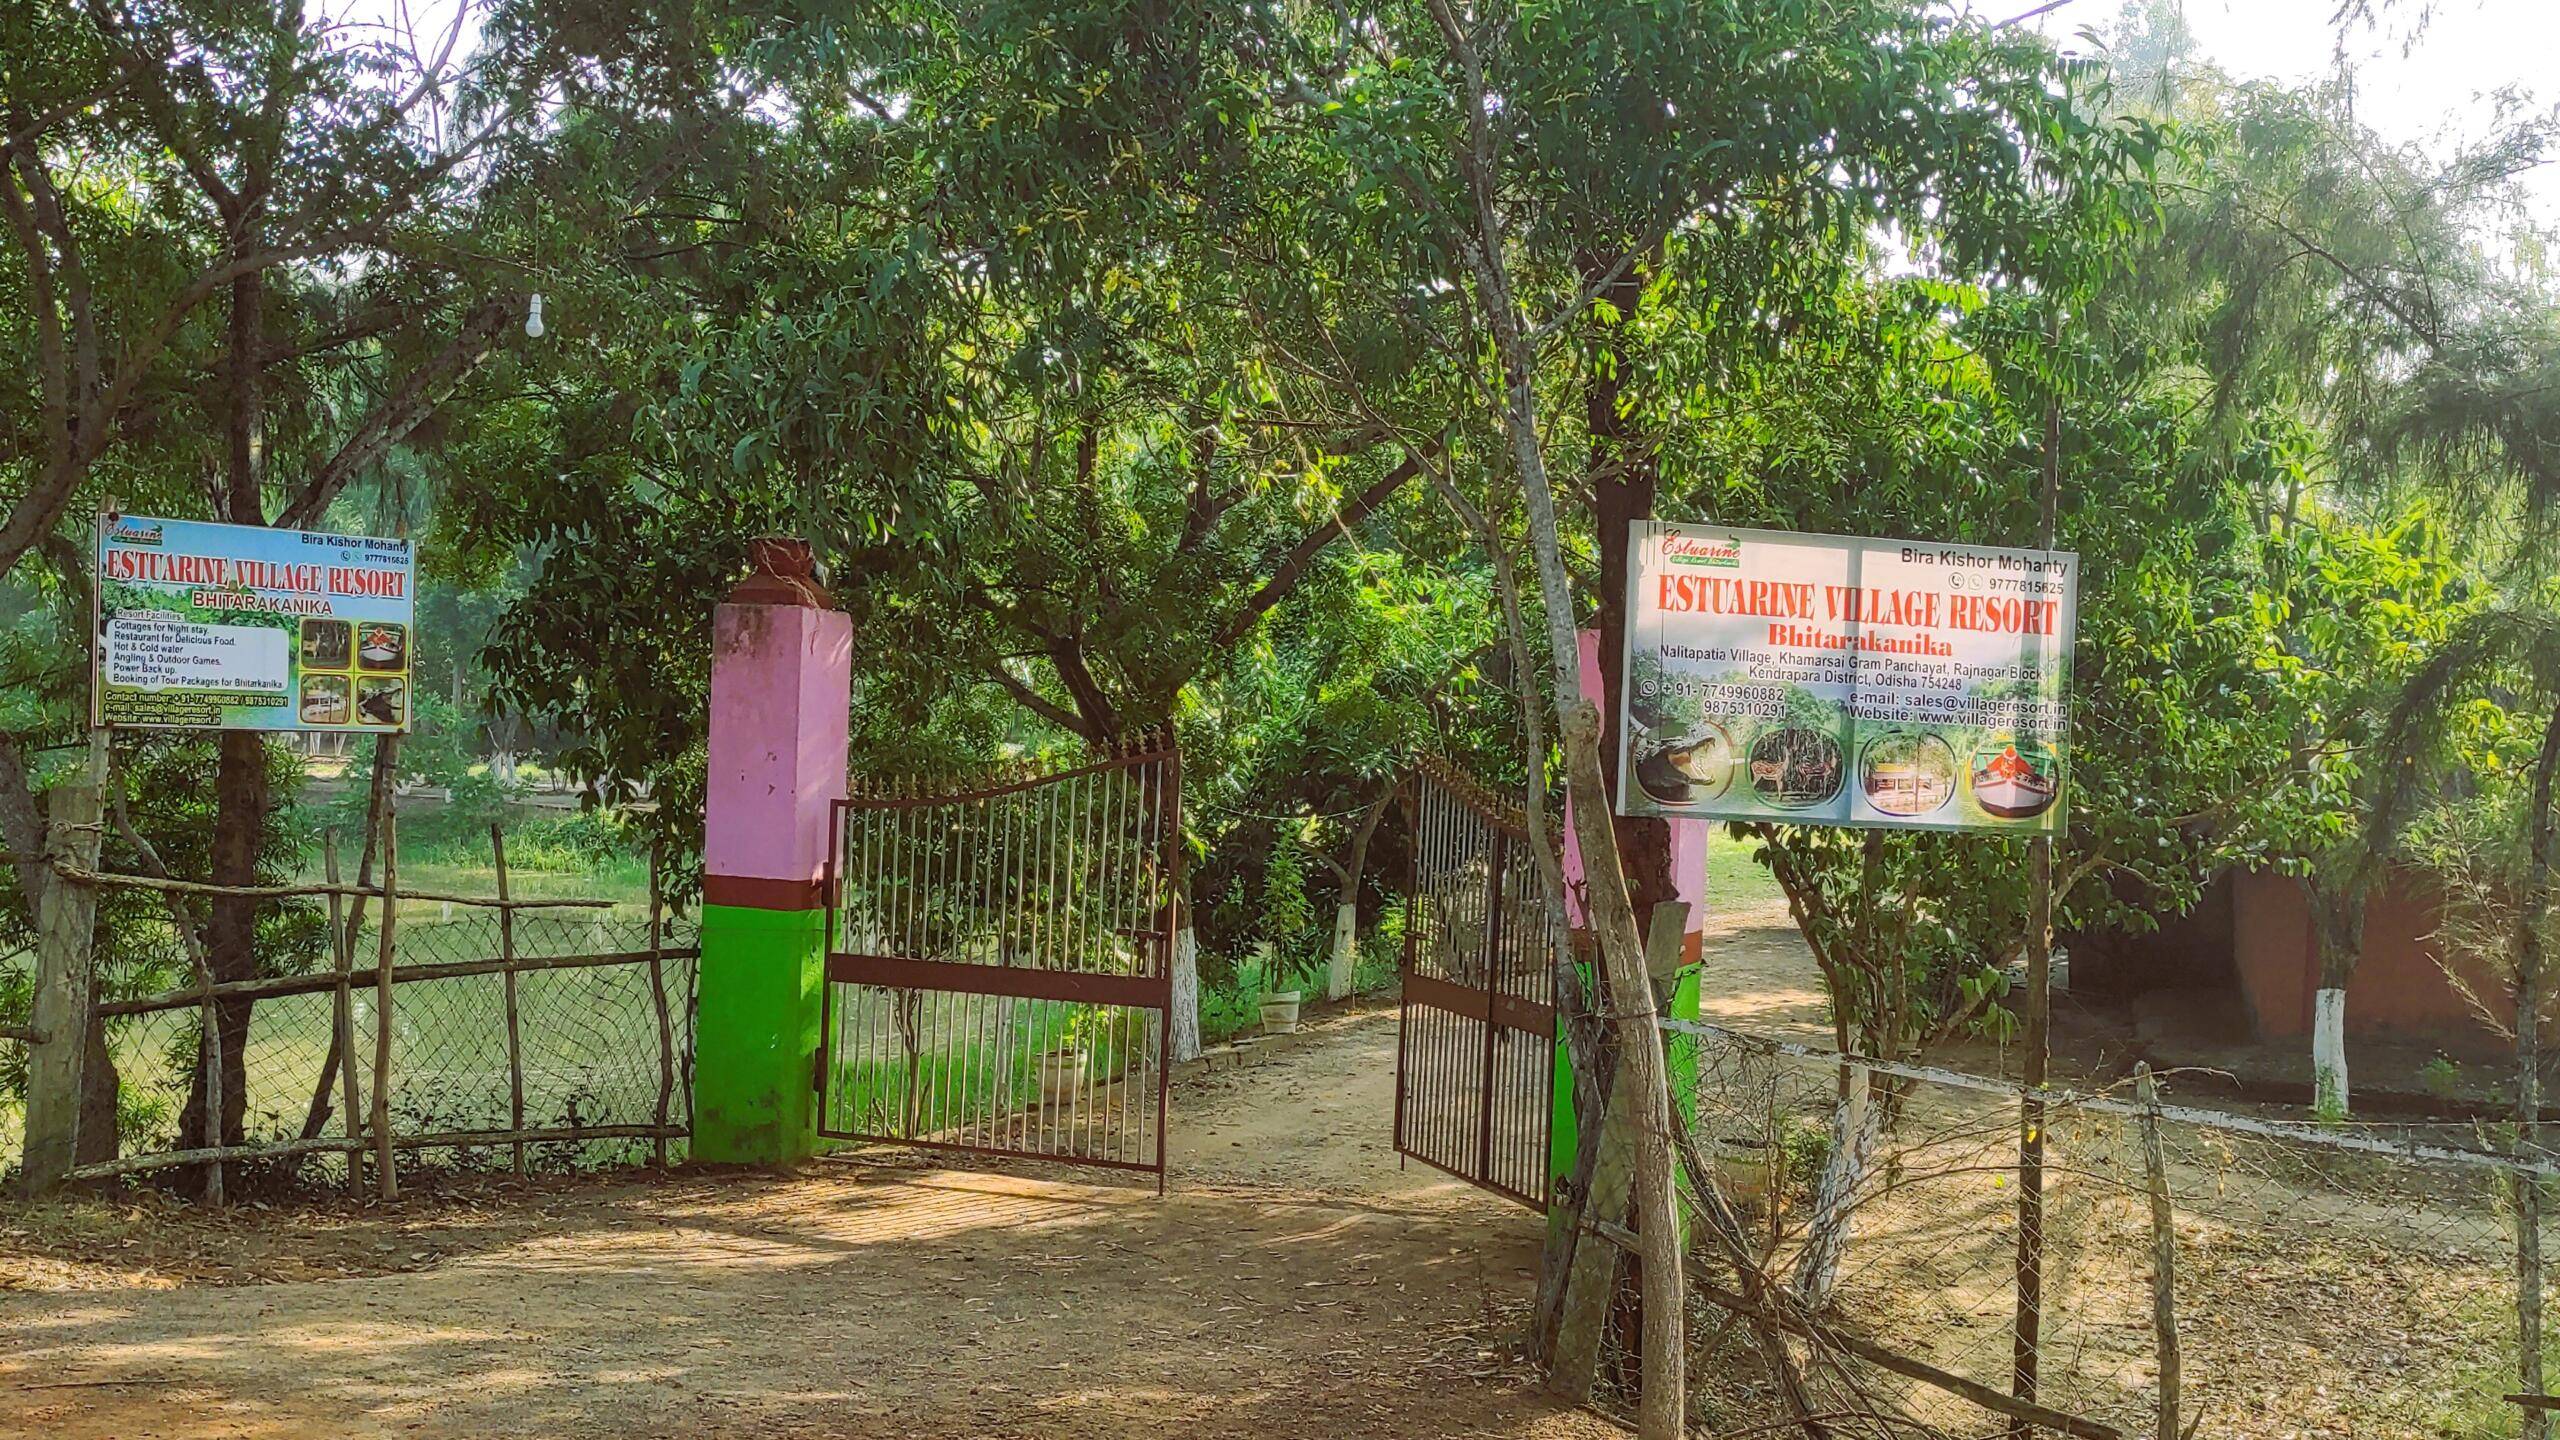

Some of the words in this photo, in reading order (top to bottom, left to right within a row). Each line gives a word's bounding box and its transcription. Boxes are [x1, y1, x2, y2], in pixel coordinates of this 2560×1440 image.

[302, 533, 323, 545] Bira
[326, 536, 361, 549] Kishor
[365, 539, 409, 554] Mohanty
[1661, 529, 1741, 558] Estuarine
[1901, 548, 1934, 565] Bira
[1939, 550, 1993, 570] Kishor
[1998, 555, 2068, 578] Mohanty
[107, 549, 229, 587] ESTUARINE
[235, 559, 322, 594] VILLAGE
[328, 566, 407, 598] RESORT
[1989, 578, 2064, 595] 9777815625
[193, 591, 333, 615] BHITARAKANIKA
[1658, 573, 1816, 621] ESTUARINE
[1825, 585, 1940, 630] VILLAGE
[1949, 594, 2058, 636] RESORT
[117, 608, 144, 618] Resort
[114, 620, 151, 633] Cottages
[153, 623, 165, 632] for
[167, 623, 189, 634] Night
[114, 631, 160, 641] Restaurant
[161, 633, 173, 643] for
[175, 633, 212, 645] Delicious
[114, 641, 129, 651] Hot
[131, 642, 137, 651] &
[139, 642, 159, 652] Cold
[160, 645, 184, 654] water
[1768, 623, 1953, 657] Bhitarakanika
[113, 662, 140, 672] Power
[142, 663, 162, 673] Back
[114, 652, 146, 664] Angling
[148, 653, 154, 663] &
[157, 654, 190, 665] Outdoor
[1660, 645, 1726, 664] Nalitapatia
[1730, 649, 1775, 666] Village,
[1779, 652, 1845, 668] Khamarsai
[1848, 656, 1881, 671] Gram
[1885, 658, 1950, 677] Panchayat,
[1954, 662, 2007, 680] Rajnagar
[113, 673, 148, 685] Booking
[150, 675, 159, 684] of
[161, 675, 179, 685] Tour
[181, 675, 220, 688] Packages
[221, 677, 232, 687] for
[1749, 665, 1821, 682] Kendrapara
[1824, 669, 1871, 687] District,
[1875, 673, 1917, 689] Odisha
[1921, 676, 1962, 691] 754248
[104, 691, 138, 702] Contact
[1702, 684, 1785, 701] 7749960882
[1704, 700, 1786, 717] 9875310291
[1849, 691, 1900, 706] e-mail:
[1904, 694, 2067, 716] sales@villageresort.in
[1849, 705, 1913, 722] Website:
[1918, 711, 2067, 731] www.villageresort.in
